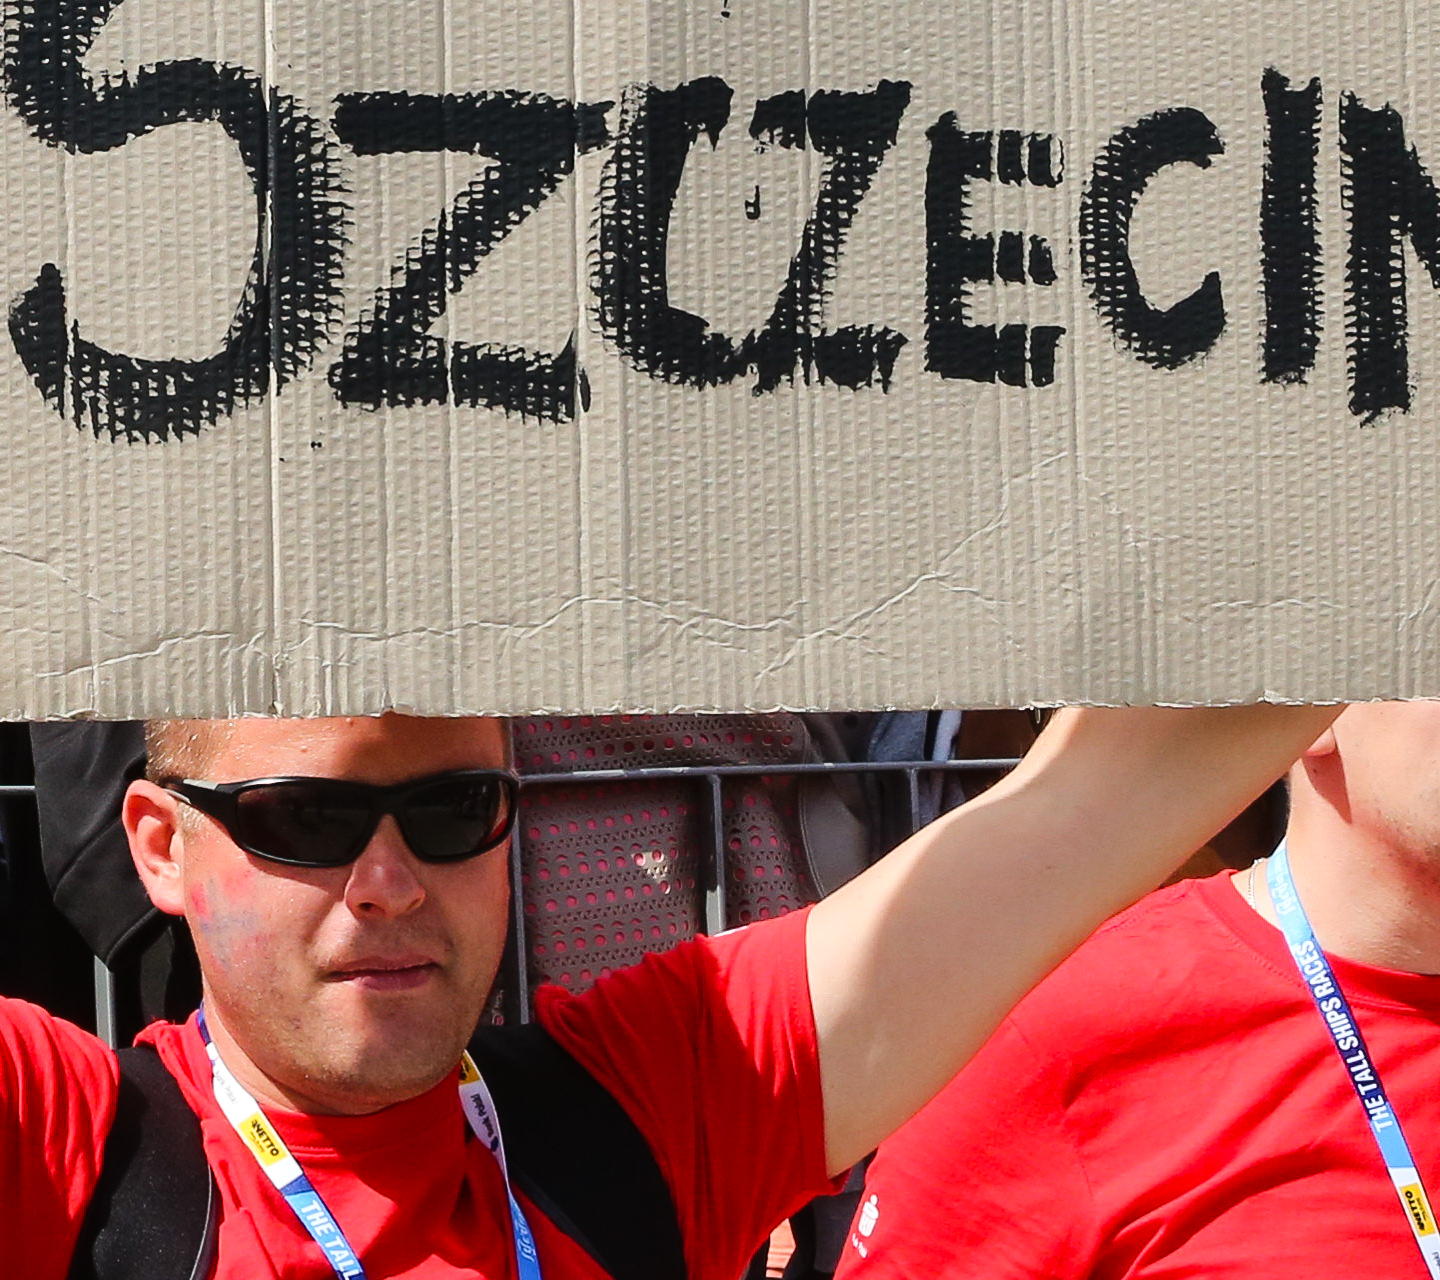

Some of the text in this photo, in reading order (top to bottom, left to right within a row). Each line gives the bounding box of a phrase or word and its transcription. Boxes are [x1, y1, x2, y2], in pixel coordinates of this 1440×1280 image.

[1296, 940, 1394, 1133] THE TALL SHIPS RACES
[300, 1199, 335, 1240] THE
